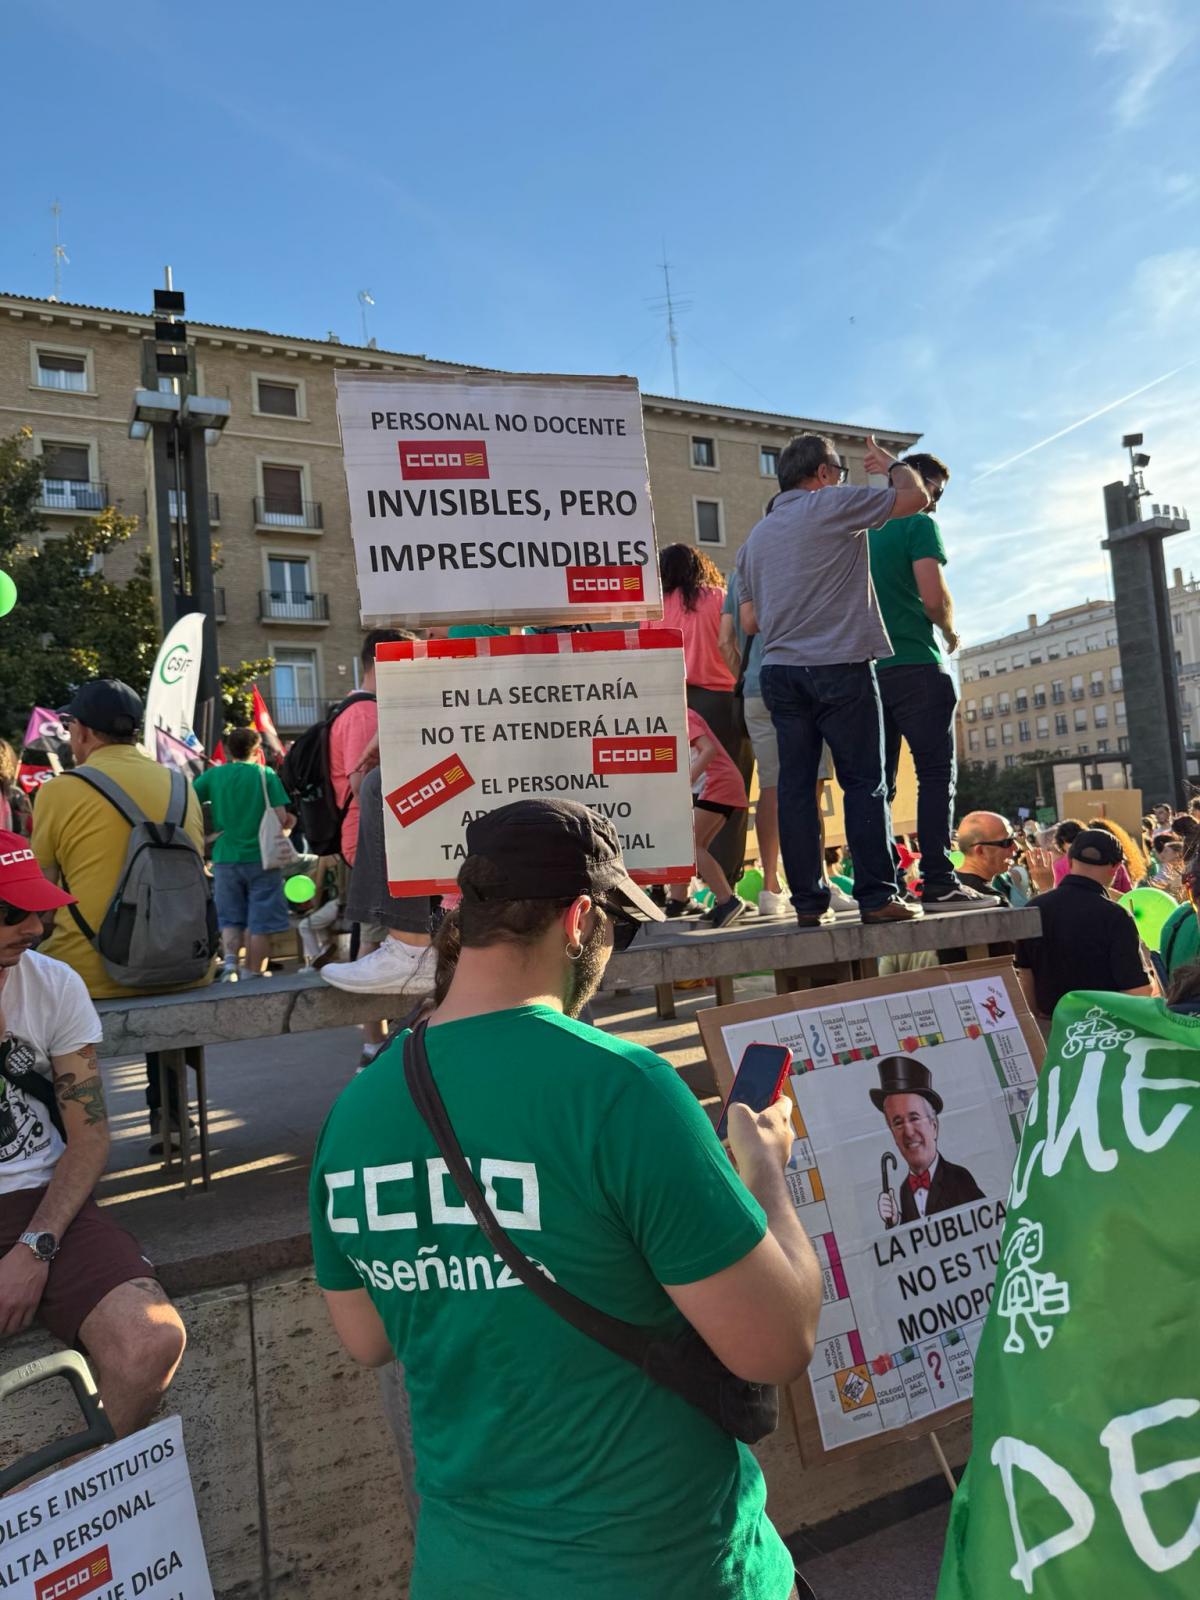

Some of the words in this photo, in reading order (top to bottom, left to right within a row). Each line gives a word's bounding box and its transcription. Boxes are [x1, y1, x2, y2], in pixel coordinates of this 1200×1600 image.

[371, 411, 490, 432] PERSONAL
[495, 414, 528, 432] NO
[534, 415, 627, 437] DOCENTE
[405, 453, 461, 467] CCOO
[367, 488, 551, 521] INVISIBLES,
[561, 489, 638, 516] PERO
[369, 540, 649, 573] IMPRESCINDIBLES
[572, 578, 621, 591] CCOO
[167, 656, 193, 673] CSIF
[442, 688, 470, 708] EN
[477, 687, 503, 706] LA
[509, 677, 638, 704] SECRETARÍA
[421, 726, 455, 745] NO
[460, 725, 486, 743] TE
[492, 714, 608, 742] ATENDERÁ
[614, 717, 640, 736] LA
[646, 716, 668, 734] IA
[599, 749, 651, 762] CCOO
[396, 777, 446, 815] CCOO
[481, 778, 502, 795] EL
[508, 773, 609, 793] PERSONAL
[0, 849, 34, 866] CCO
[324, 1156, 542, 1234] CCOO
[873, 1235, 906, 1267] LA
[909, 1199, 1007, 1254] PÚBLICA
[347, 1244, 557, 1292] nseñanz
[898, 1265, 937, 1300] NO
[939, 1252, 972, 1285] ES
[972, 1239, 1001, 1271] TU
[834, 1338, 846, 1369] COLEGIO
[949, 1349, 970, 1362] COLEGIO
[877, 1385, 903, 1398] COLEGIO
[904, 1371, 925, 1385] COLEGIO
[48, 1496, 60, 1519] E
[64, 1438, 175, 1510] INSTITUTOS
[53, 1489, 156, 1560] PERSONAL
[41, 1567, 90, 1600] CCOO
[131, 1550, 183, 1596] DIGA
